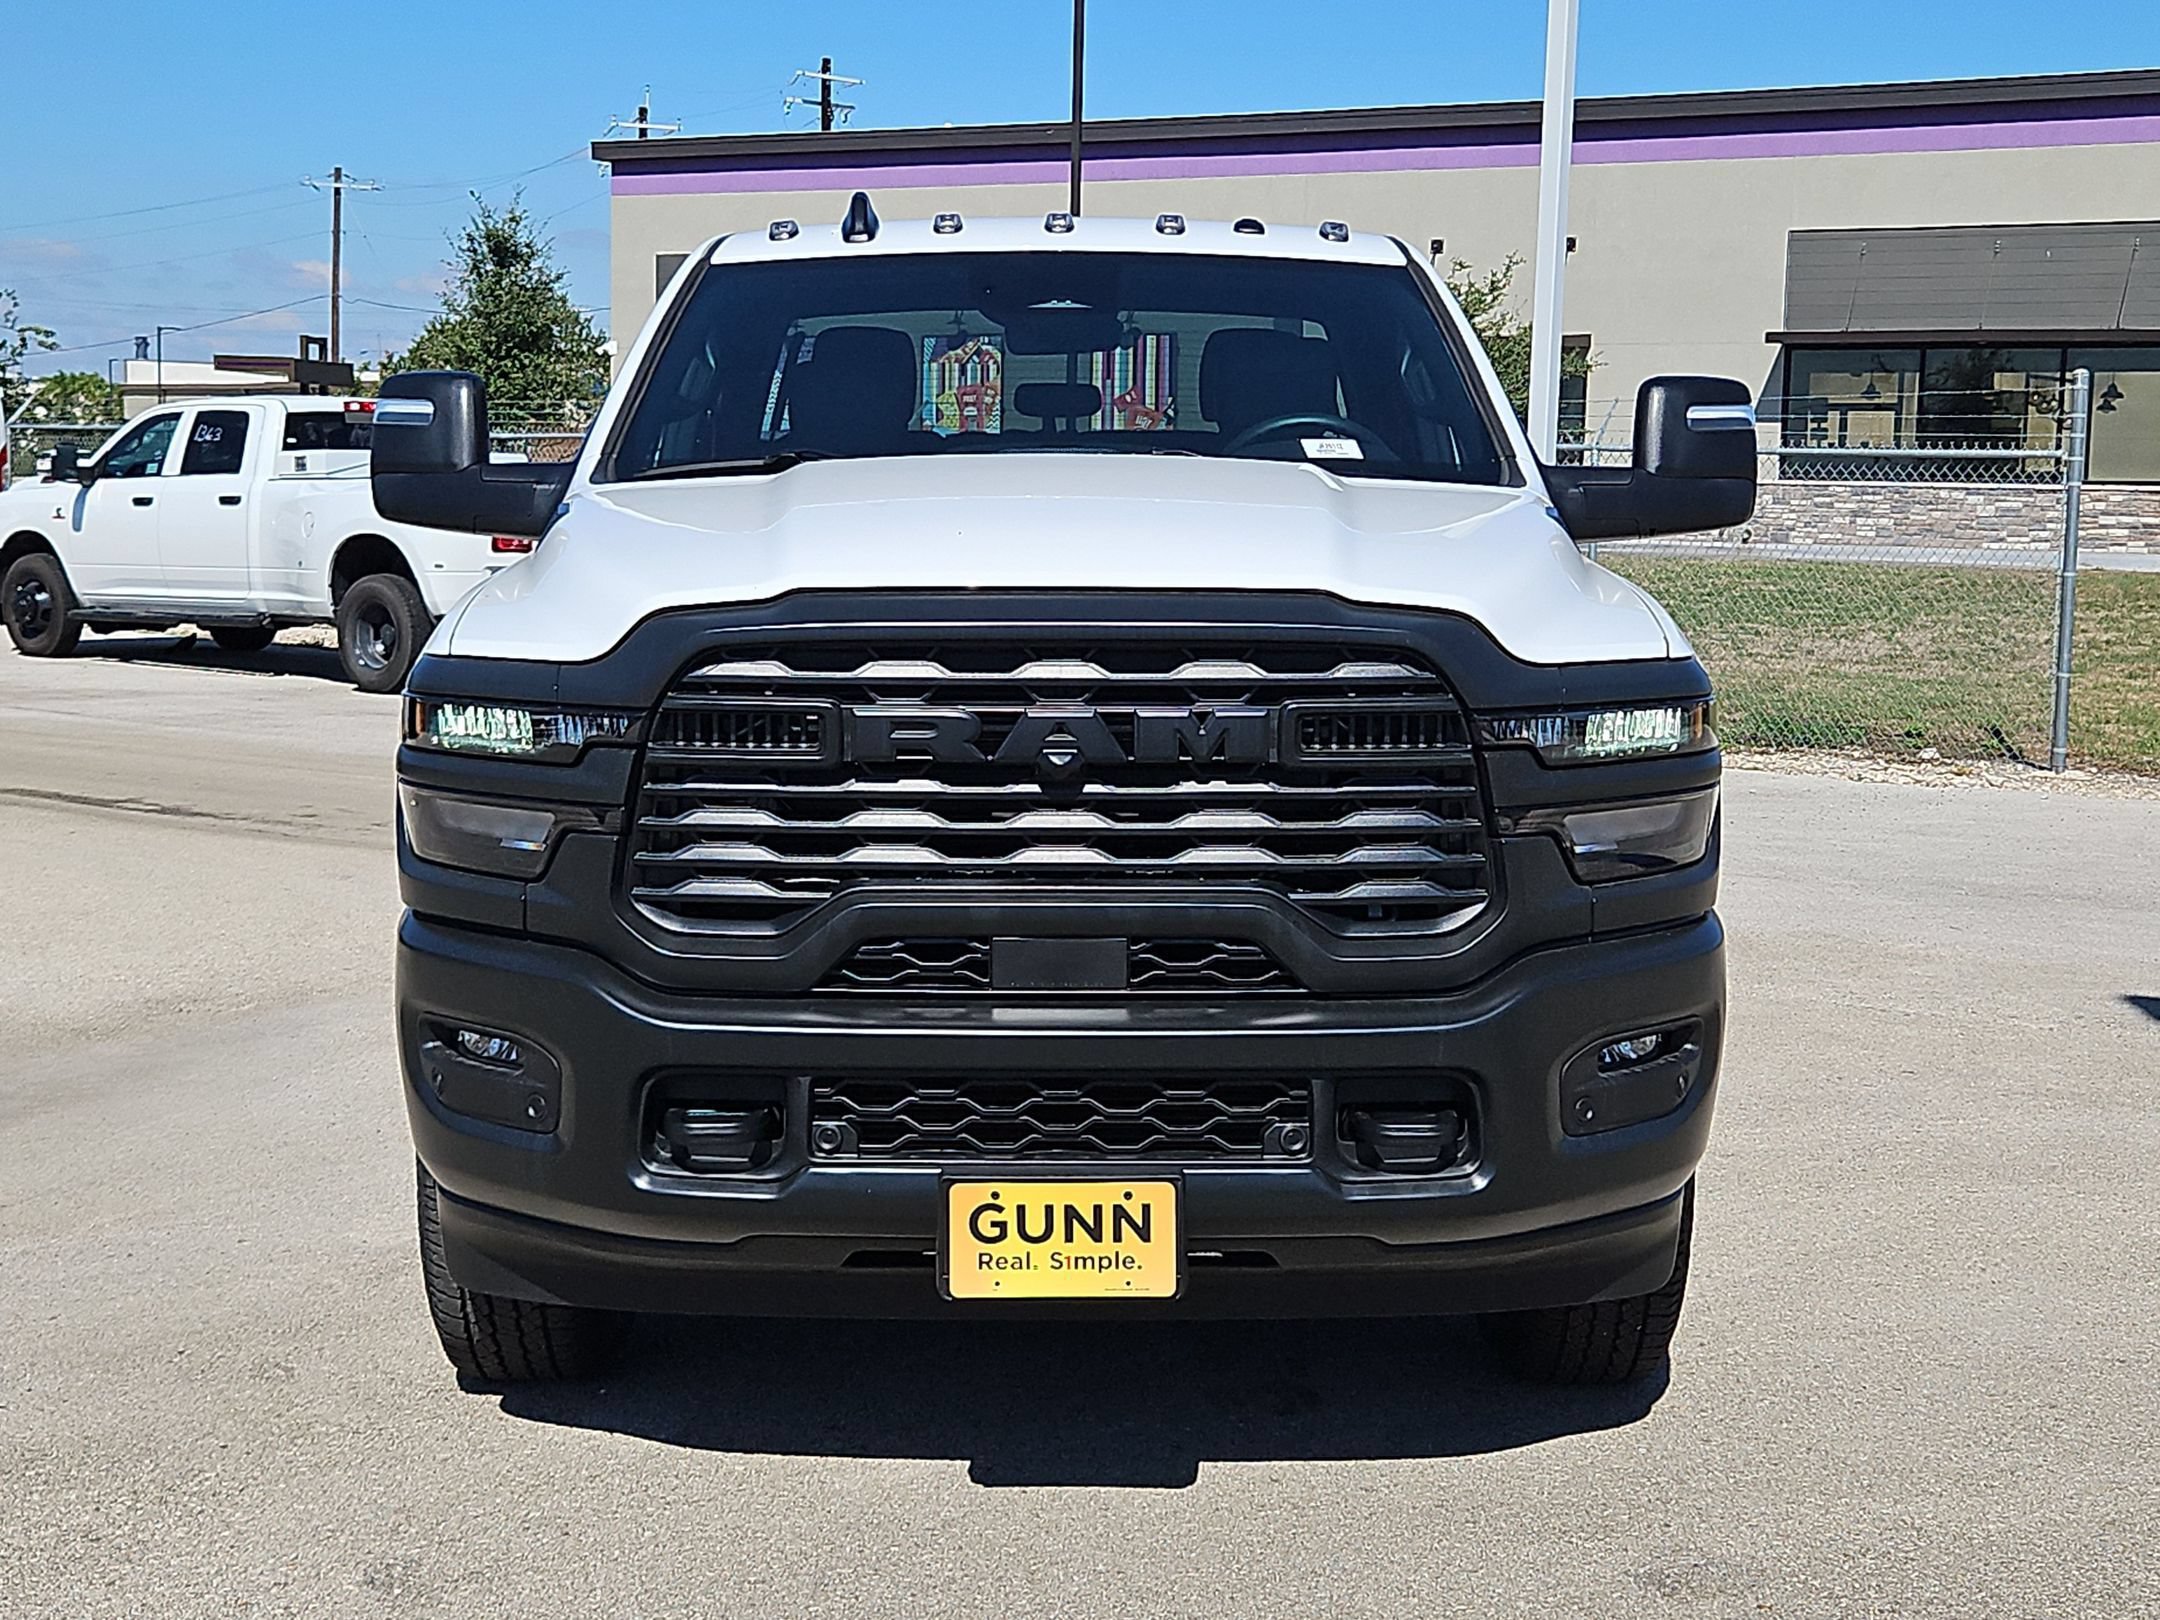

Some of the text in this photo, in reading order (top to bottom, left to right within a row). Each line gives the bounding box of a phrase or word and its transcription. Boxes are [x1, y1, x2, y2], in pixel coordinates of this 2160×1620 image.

[851, 705, 1269, 764] RAM
[968, 1202, 1151, 1244] GUNN
[978, 1251, 1039, 1270] Real.
